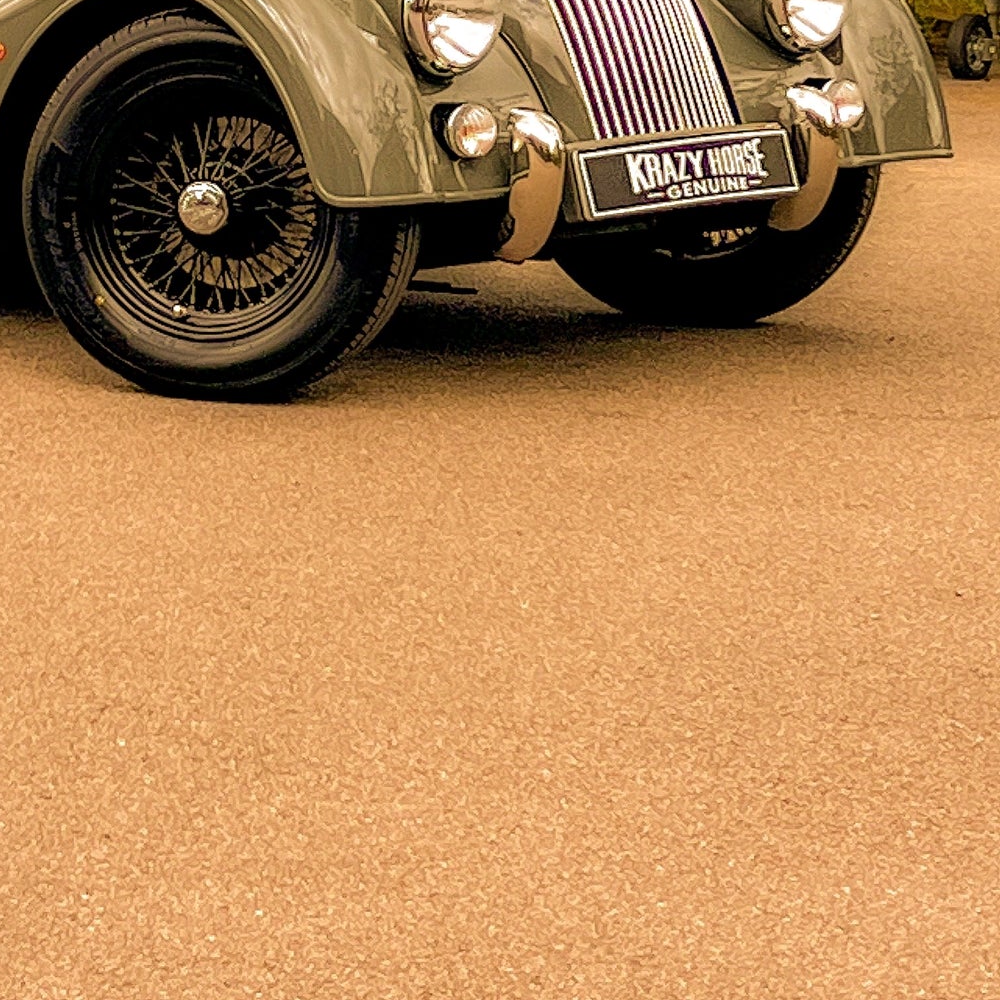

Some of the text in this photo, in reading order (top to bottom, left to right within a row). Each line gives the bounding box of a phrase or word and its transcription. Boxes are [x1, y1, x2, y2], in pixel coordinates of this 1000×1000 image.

[624, 137, 767, 195] KRAZY HORSE
[666, 175, 749, 199] GENUINE
